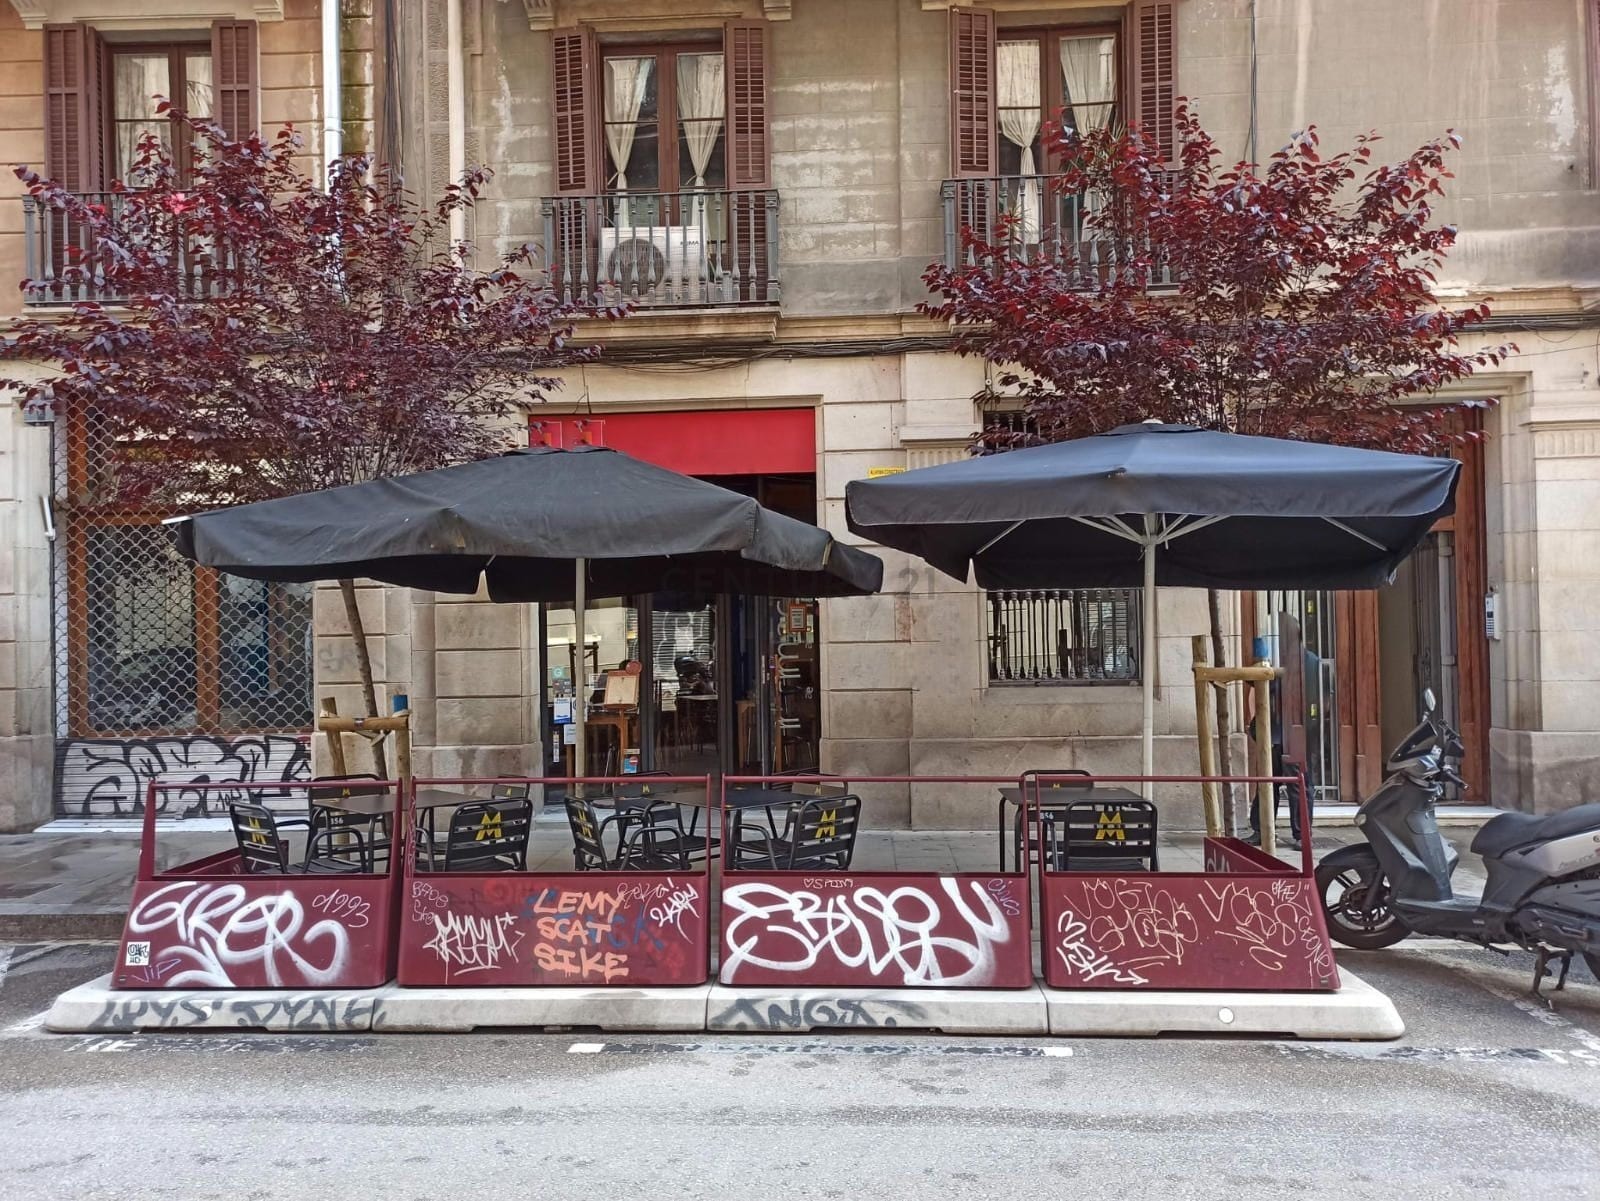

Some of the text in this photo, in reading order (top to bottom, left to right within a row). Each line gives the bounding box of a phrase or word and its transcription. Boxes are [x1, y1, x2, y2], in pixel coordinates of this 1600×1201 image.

[1096, 811, 1126, 840] M
[533, 888, 622, 923] LEMY
[536, 917, 611, 944] SCAT
[533, 943, 629, 984] SIKE
